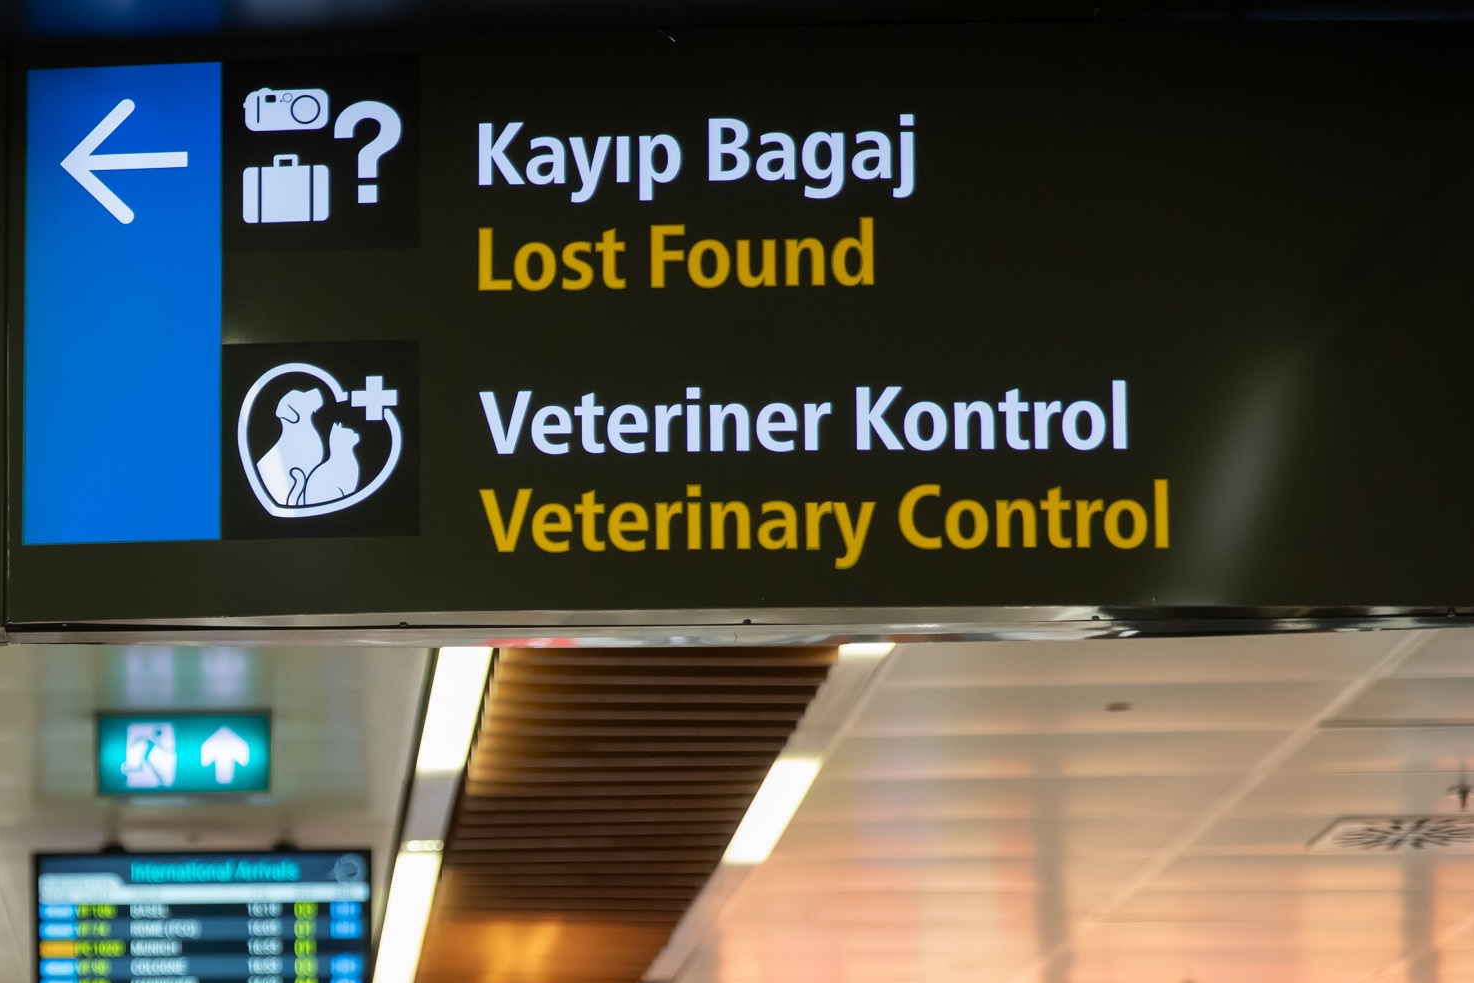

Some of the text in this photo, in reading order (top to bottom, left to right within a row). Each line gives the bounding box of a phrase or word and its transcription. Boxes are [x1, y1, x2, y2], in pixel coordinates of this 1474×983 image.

[479, 114, 916, 205] Kayıp Bagaj
[479, 218, 875, 292] Lost Found
[479, 380, 1129, 456] Veteriner Kontrol
[481, 480, 1170, 569] Veterinary Control
[235, 860, 300, 882] Arrivals
